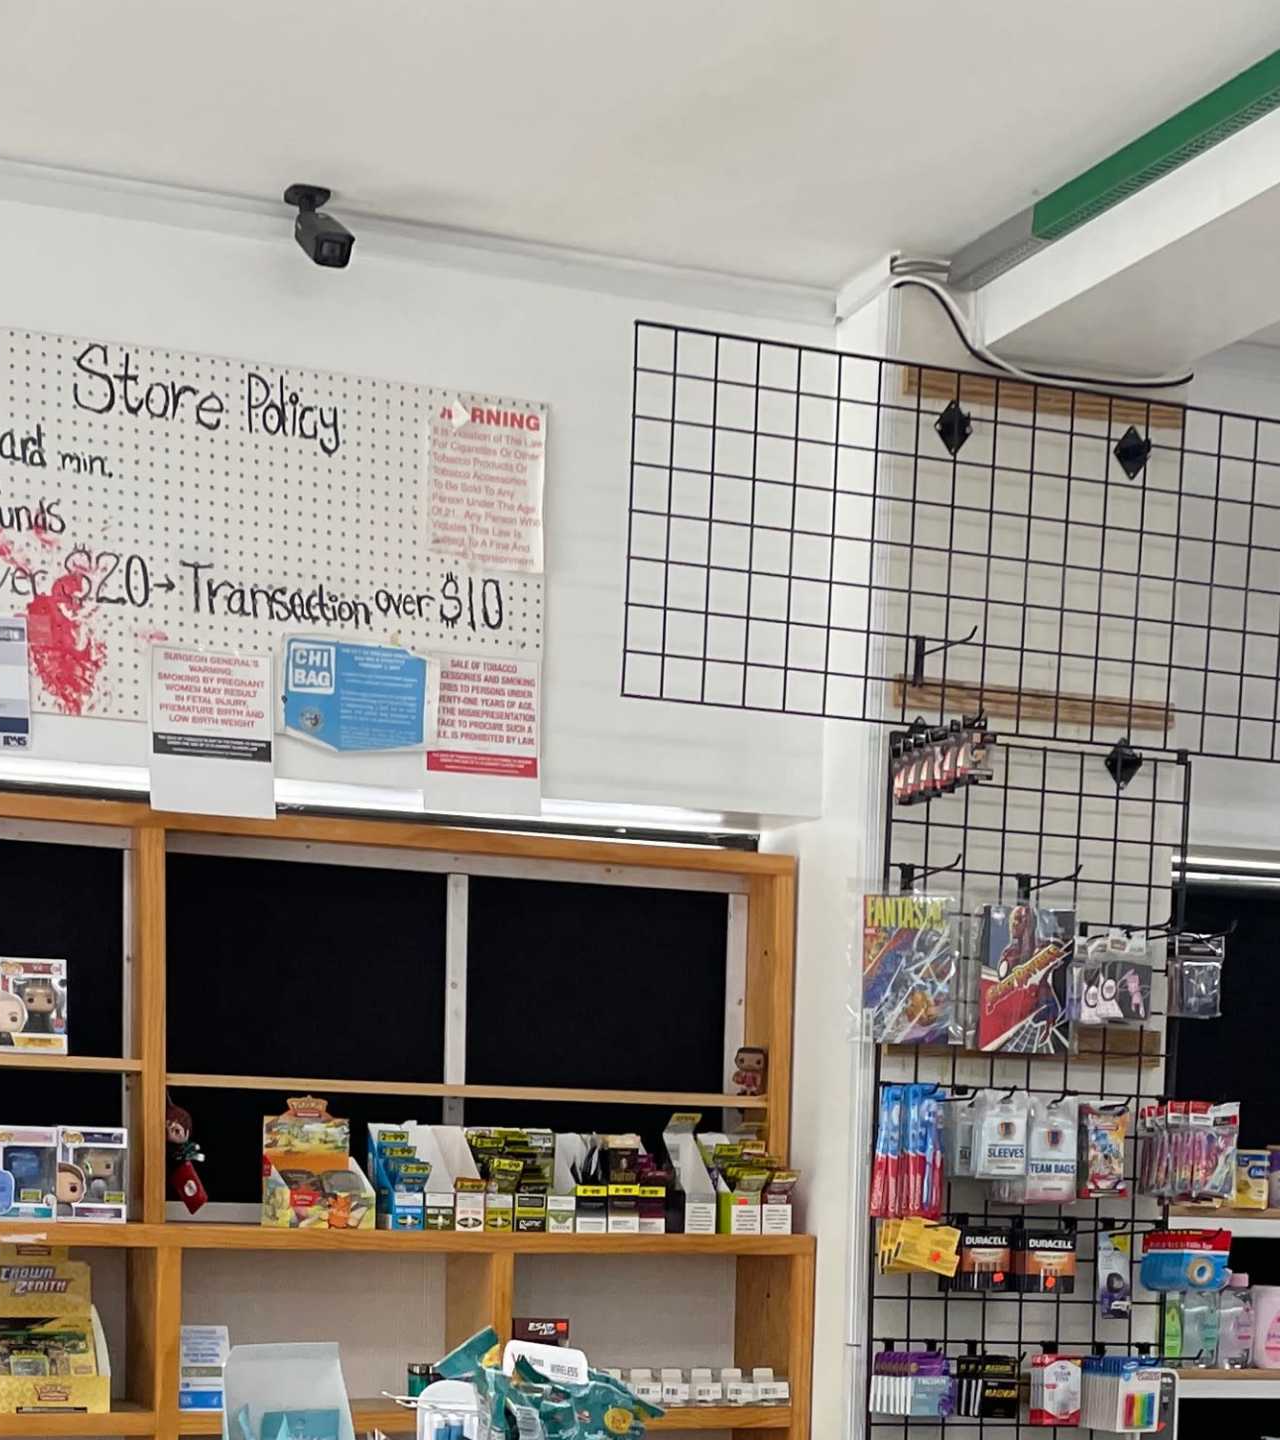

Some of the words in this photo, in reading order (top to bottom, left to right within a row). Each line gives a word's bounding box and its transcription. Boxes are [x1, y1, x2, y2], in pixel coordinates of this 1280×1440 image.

[73, 343, 224, 430] Store
[247, 372, 341, 455] Policy
[179, 559, 371, 626] Transaction
[376, 587, 435, 618] over
[439, 571, 503, 631] $10
[295, 649, 329, 666] CHI
[483, 662, 518, 674] TOBACCO
[158, 672, 201, 683] SMOKING
[202, 676, 214, 685] BY
[216, 677, 265, 688] PREGNANT
[294, 669, 331, 687] BAG
[484, 674, 500, 684] AND
[501, 676, 536, 688] SMOKING
[165, 684, 201, 694] WOMEN
[461, 684, 470, 694] TO
[169, 715, 189, 723] LOW
[987, 1147, 1024, 1160] SLEEVES
[1029, 1162, 1052, 1174] TEAM
[1054, 1163, 1076, 1176] BAGS
[965, 1234, 1008, 1247] DURACELL
[1029, 1238, 1073, 1251] DURACELL
